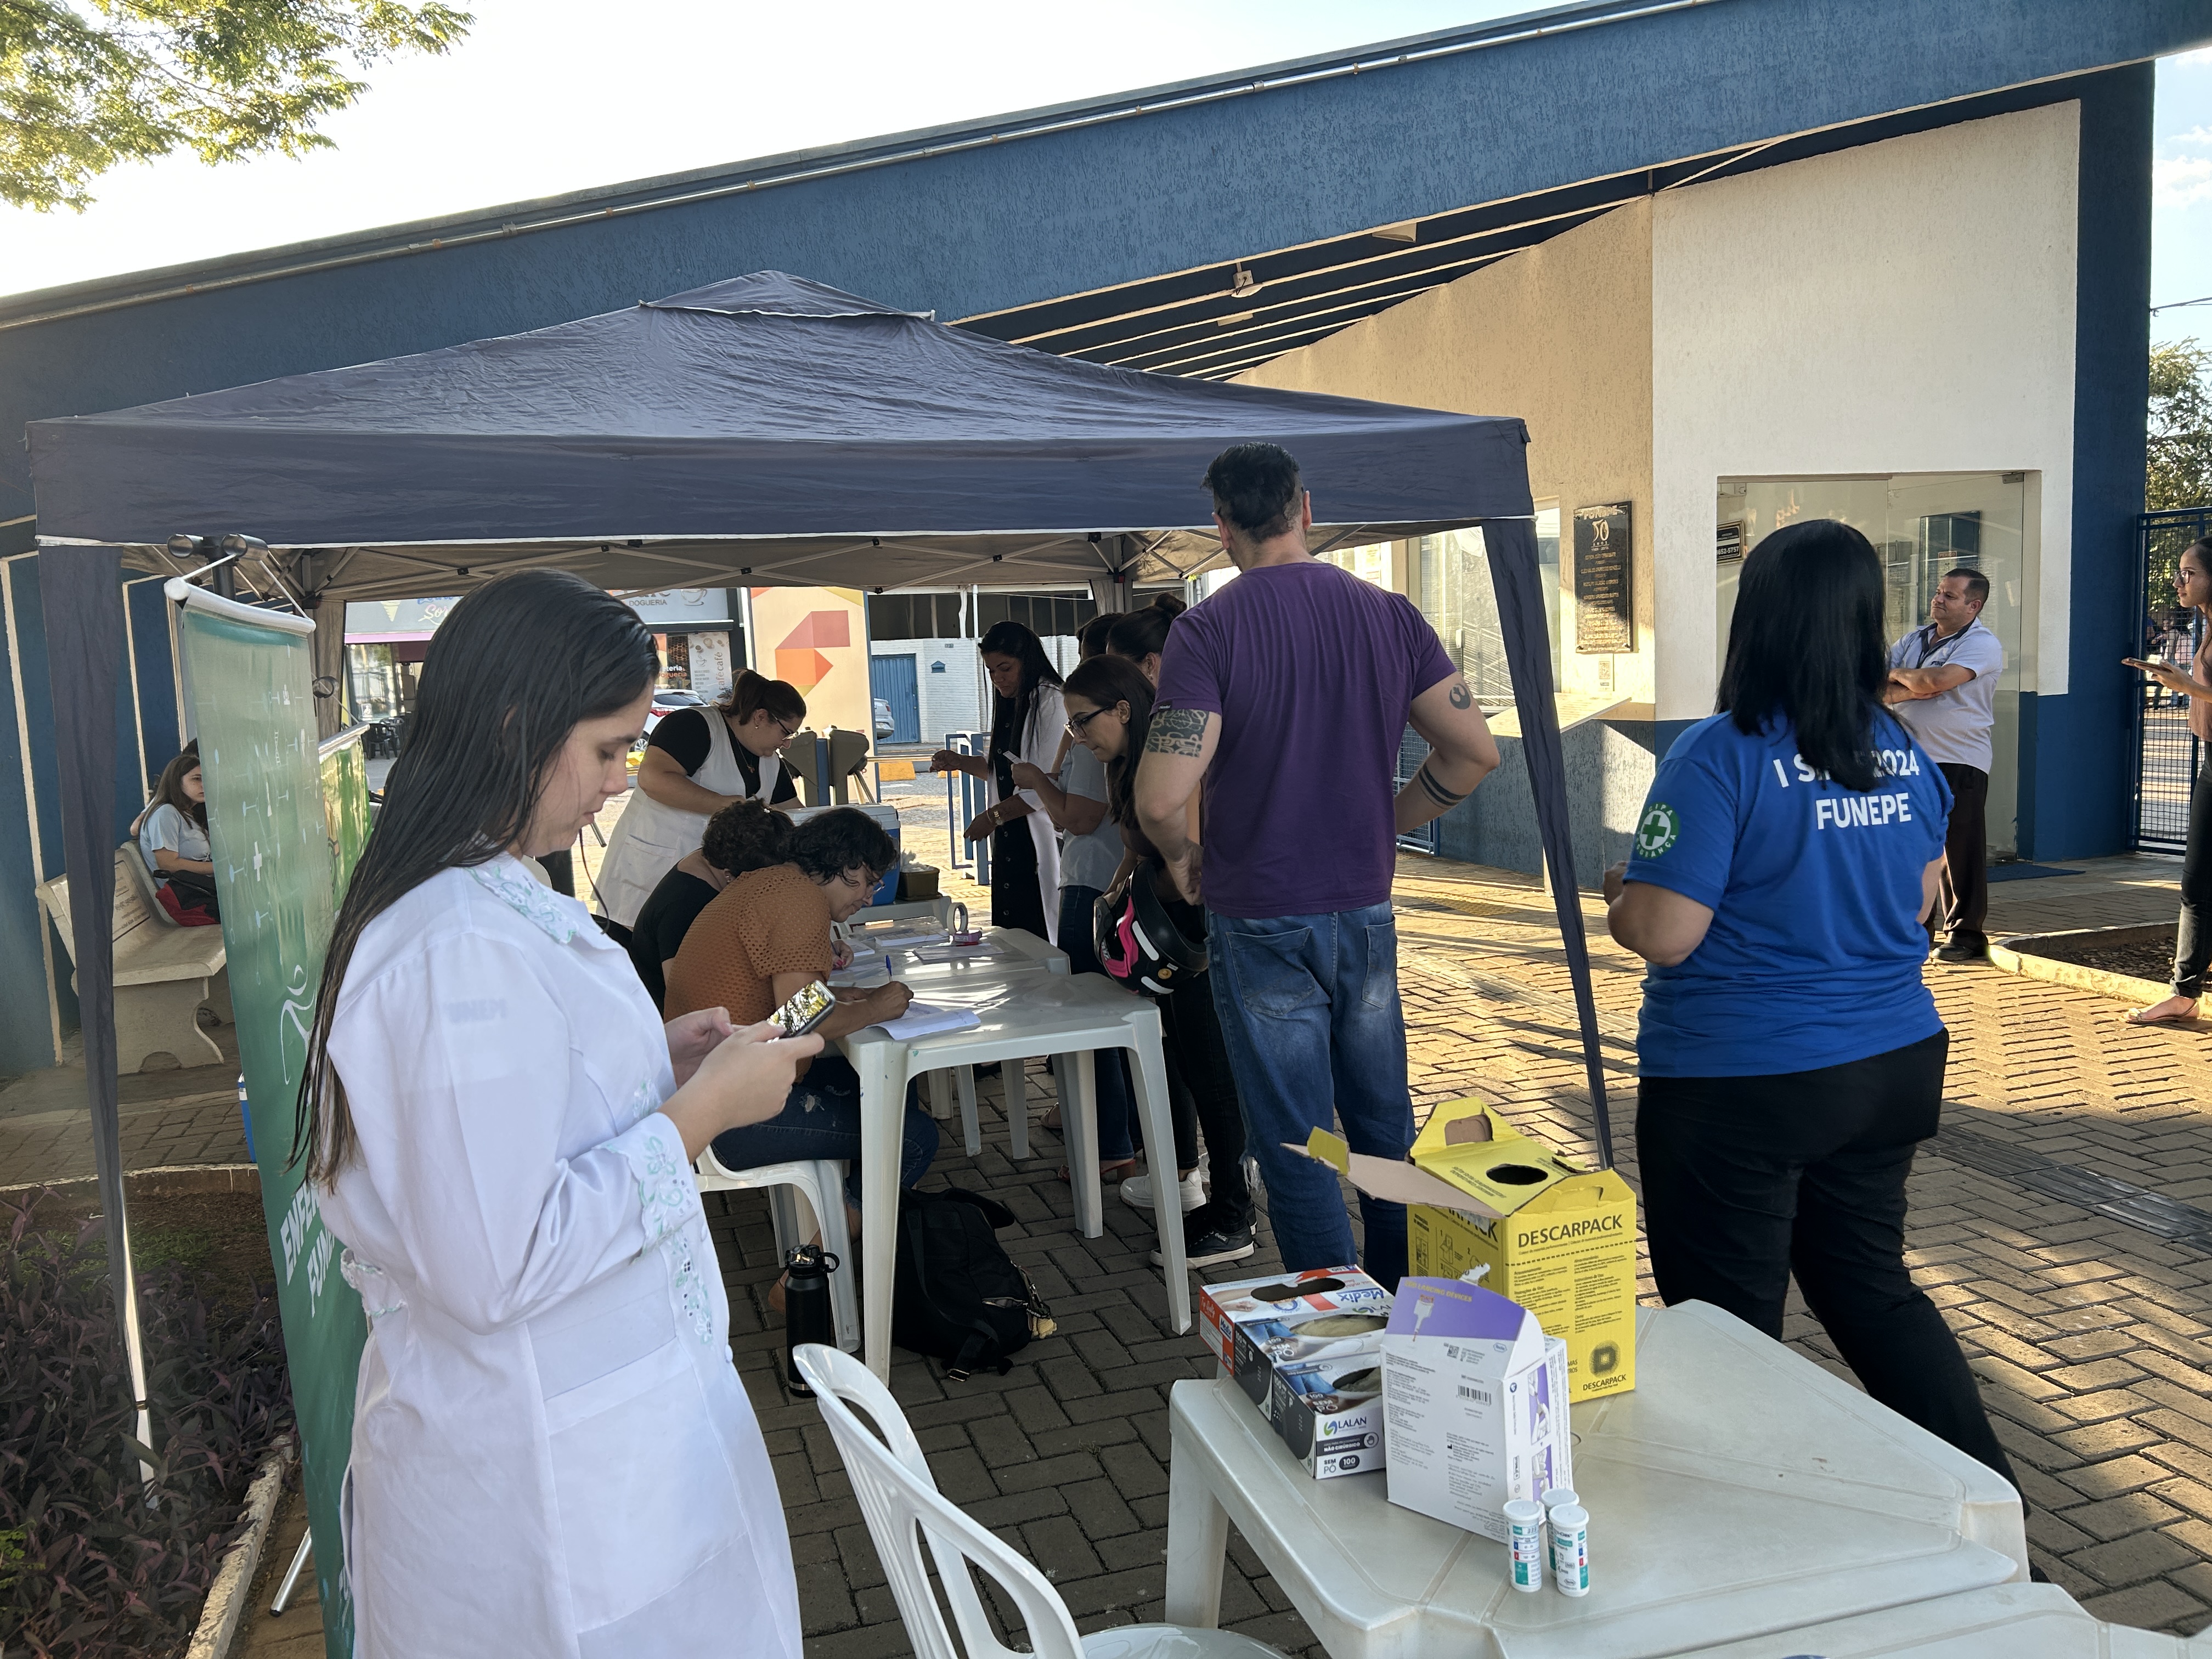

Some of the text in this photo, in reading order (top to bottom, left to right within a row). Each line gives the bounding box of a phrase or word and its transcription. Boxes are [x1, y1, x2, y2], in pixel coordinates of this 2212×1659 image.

[1871, 749, 1920, 778] 2024
[1649, 803, 1673, 816] CIPA
[1816, 792, 1911, 830] FUNEPE
[1518, 1214, 1623, 1248] DESCARPACK
[1336, 1288, 1384, 1303] Medix
[1417, 1283, 1445, 1295] LANCING
[1446, 1290, 1472, 1303] DEVICES
[1567, 1359, 1578, 1367] MAS
[1583, 1374, 1627, 1391] DESCARPACK
[1339, 1416, 1367, 1429] LALAN
[1343, 1457, 1356, 1465] 100
